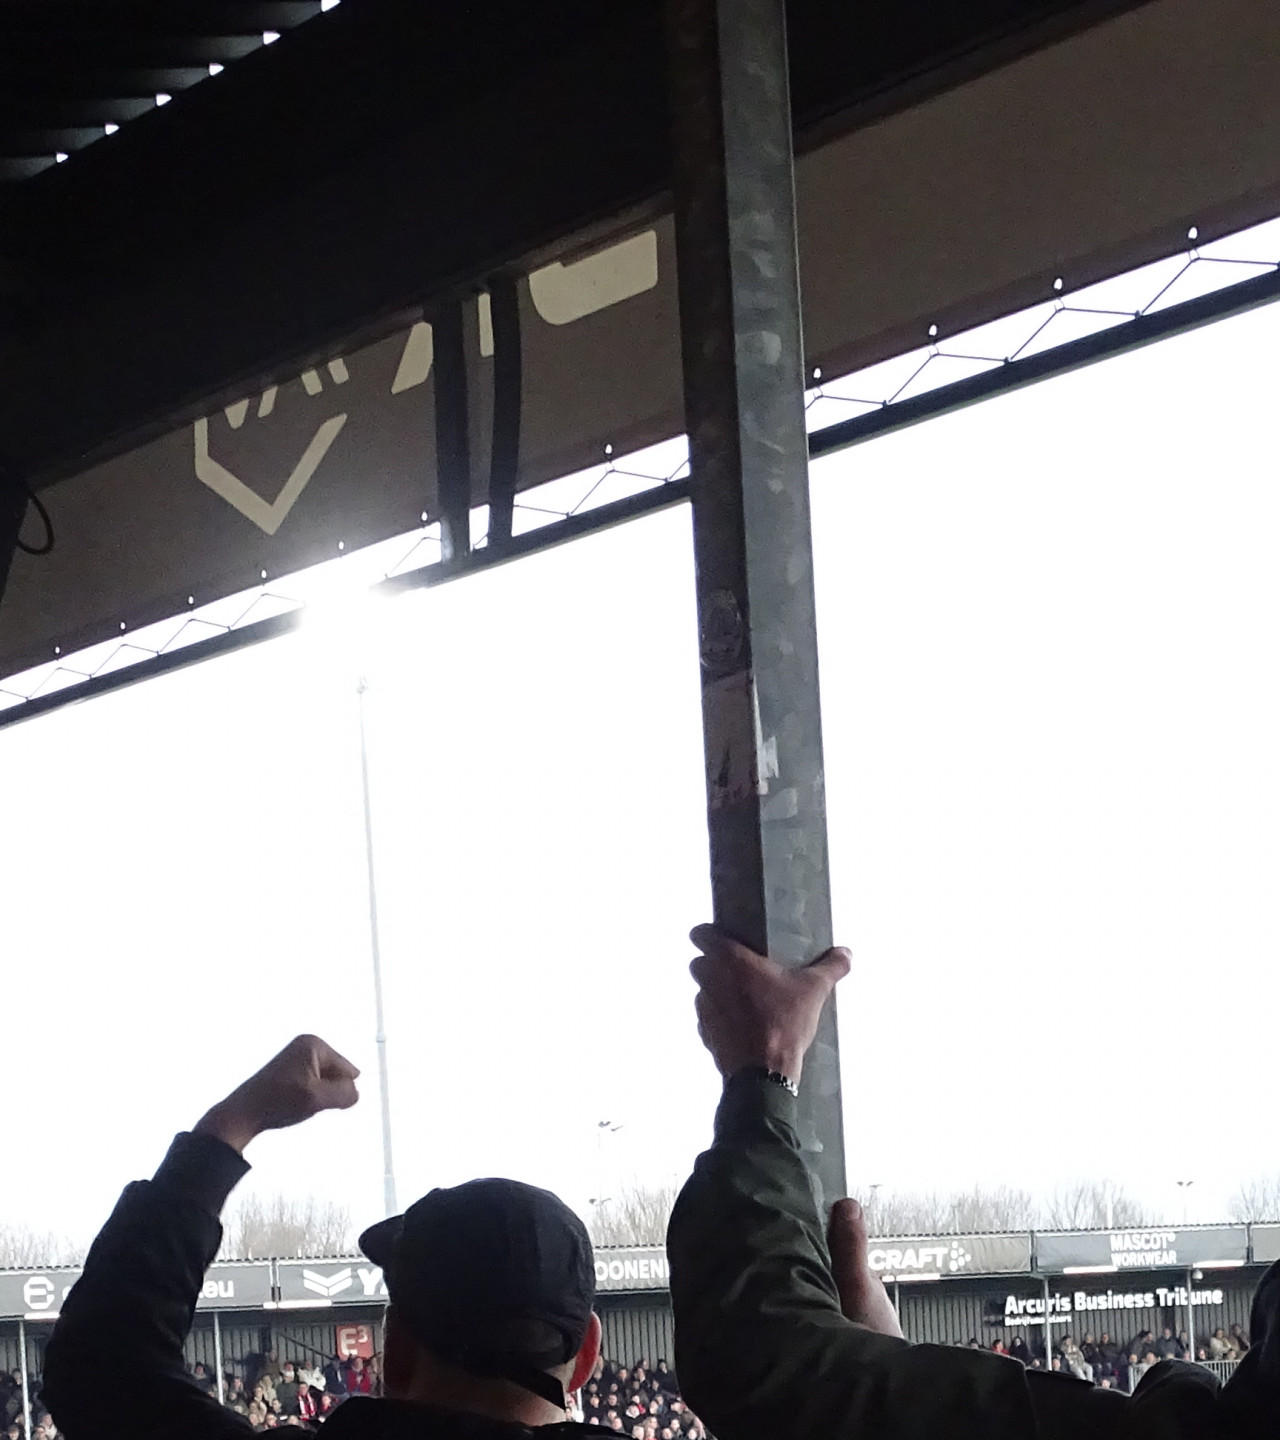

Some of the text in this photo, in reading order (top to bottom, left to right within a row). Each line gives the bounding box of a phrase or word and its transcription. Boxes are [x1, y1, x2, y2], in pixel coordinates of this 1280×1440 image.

[867, 1247, 949, 1271] CRAFT
[1111, 1251, 1177, 1267] WORKWEAR
[1005, 1293, 1071, 1315] Arcuris
[1074, 1290, 1155, 1311] Business
